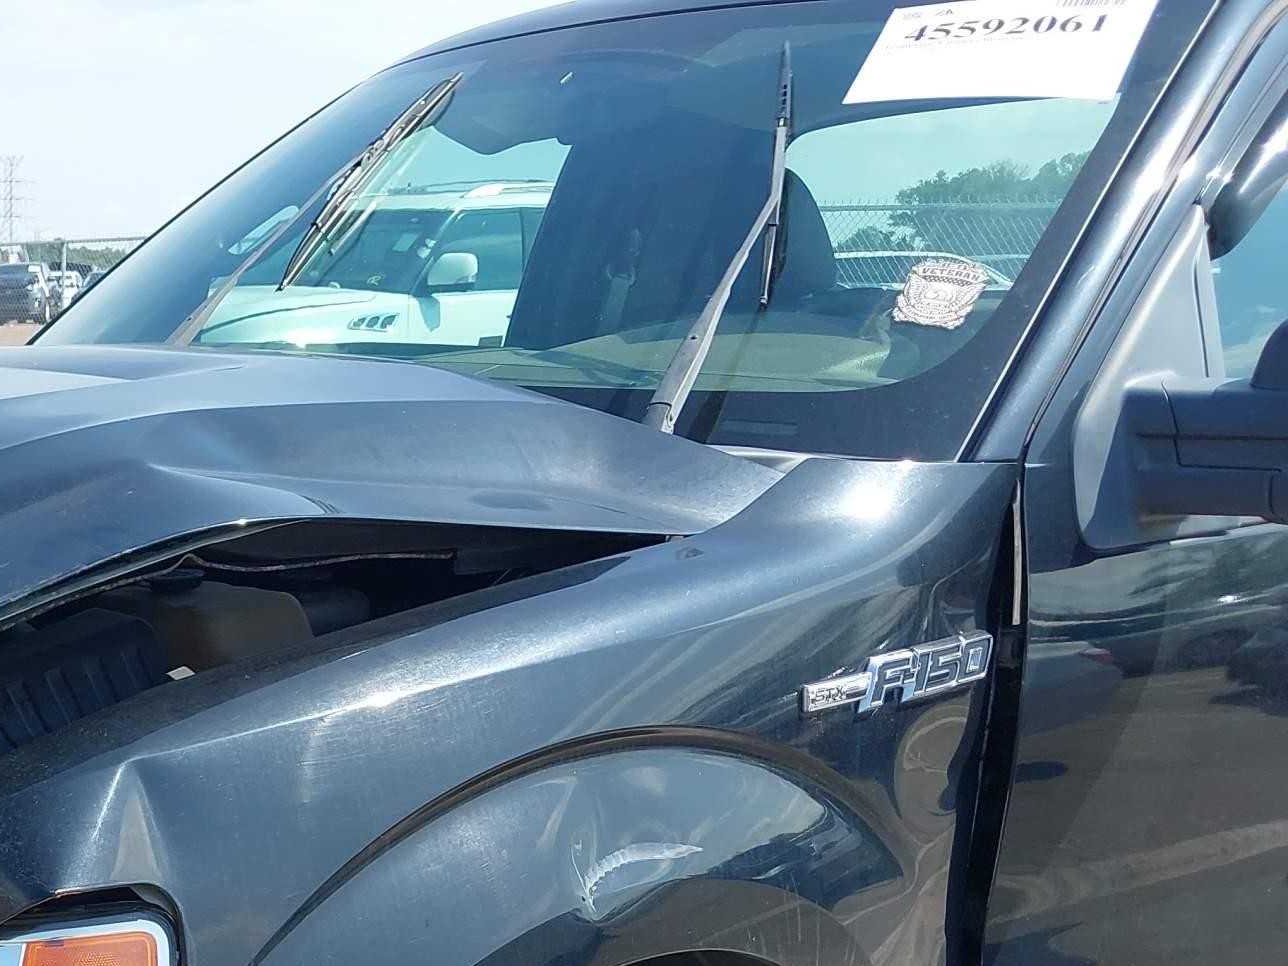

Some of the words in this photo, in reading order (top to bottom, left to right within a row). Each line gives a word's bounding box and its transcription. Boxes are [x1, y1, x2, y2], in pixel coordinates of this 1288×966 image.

[904, 14, 1109, 42] 45592061
[921, 266, 981, 282] VETERAN
[811, 685, 847, 706] STX
[857, 629, 994, 714] F-150
